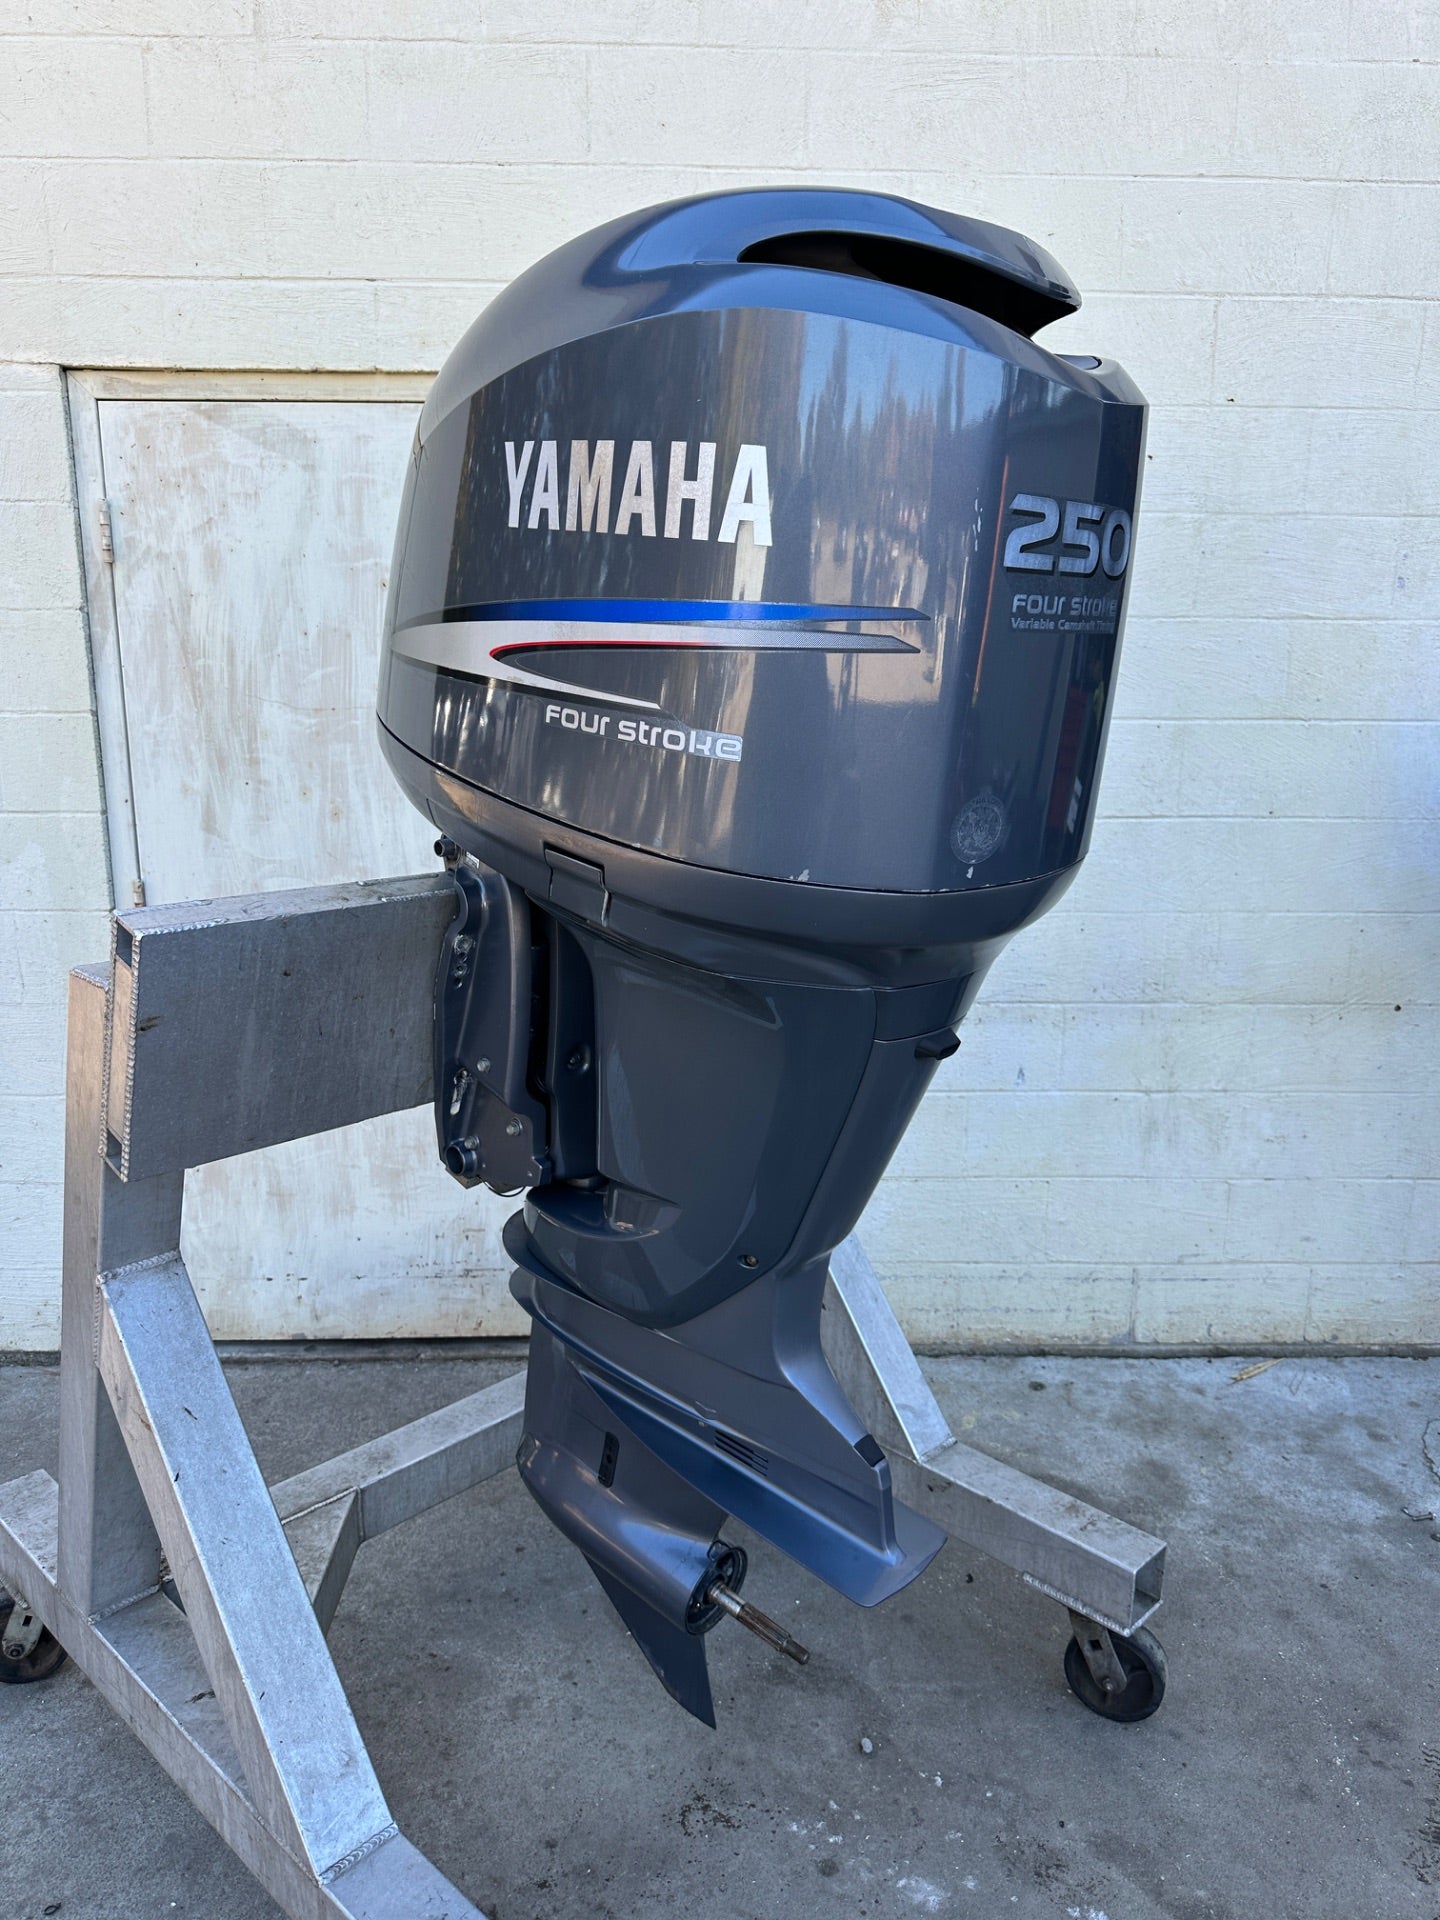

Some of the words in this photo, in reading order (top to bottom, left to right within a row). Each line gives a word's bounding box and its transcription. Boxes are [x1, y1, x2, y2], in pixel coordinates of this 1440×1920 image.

[504, 439, 773, 546] YAMAHA
[1003, 493, 1132, 580] 250
[1011, 617, 1055, 630] Variable
